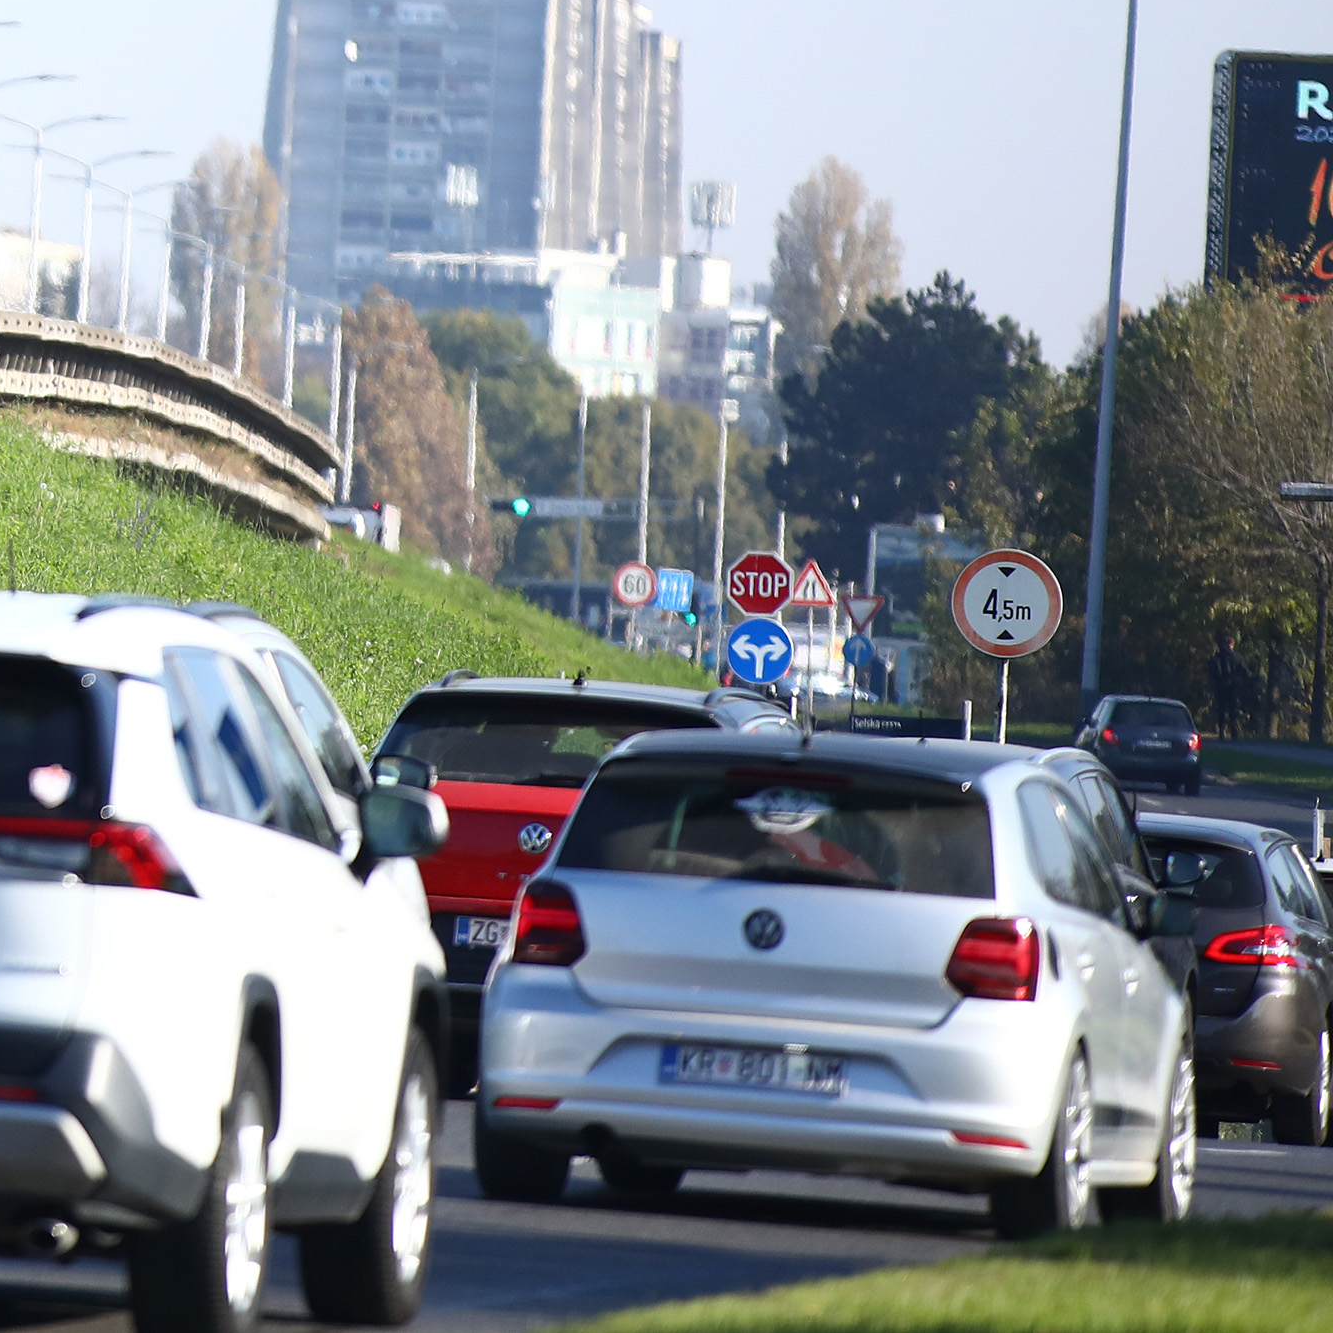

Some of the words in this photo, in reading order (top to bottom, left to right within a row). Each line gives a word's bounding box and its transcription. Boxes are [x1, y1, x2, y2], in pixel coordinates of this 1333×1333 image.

[1297, 79, 1333, 121] R
[624, 574, 646, 595] 60
[733, 571, 787, 598] STOP
[472, 920, 498, 944] ZG
